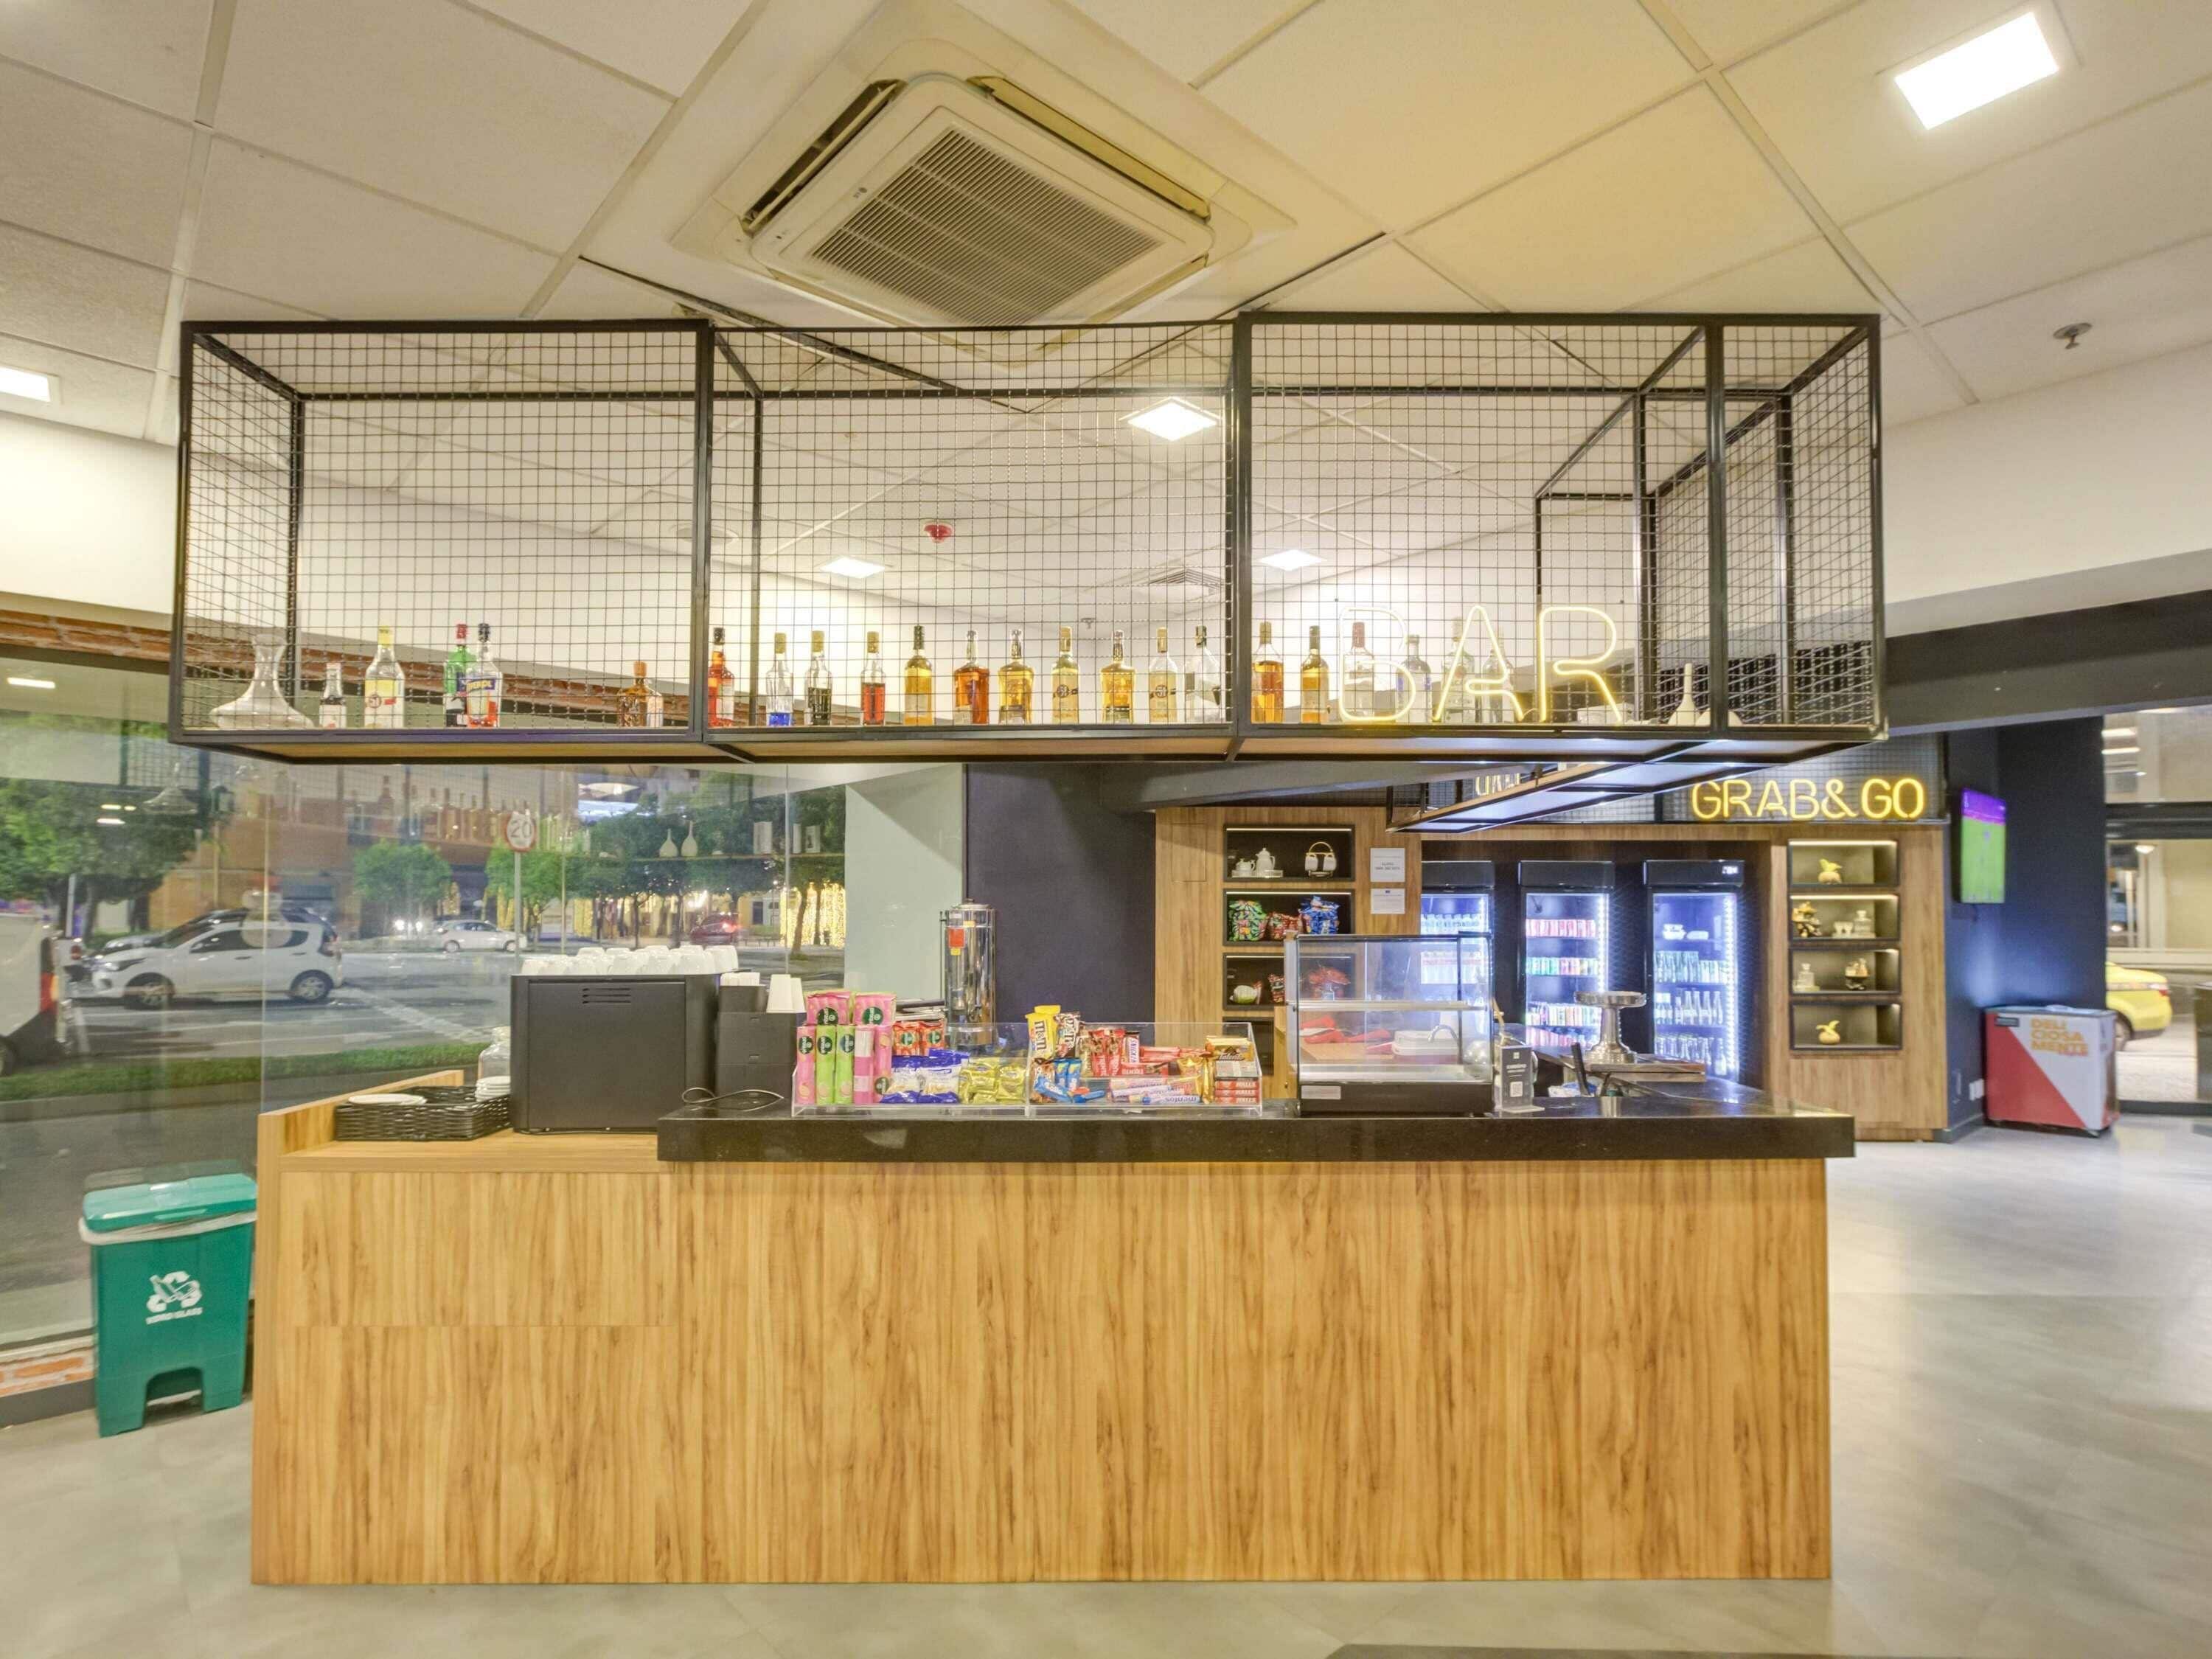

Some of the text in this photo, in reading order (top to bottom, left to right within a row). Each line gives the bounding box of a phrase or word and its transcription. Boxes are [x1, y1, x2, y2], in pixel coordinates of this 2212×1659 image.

[1338, 605, 1624, 723] BAR
[1691, 777, 1926, 820] GRAB& GO
[510, 819, 532, 838] 20
[2030, 1018, 2066, 1029] DELI
[2030, 1040, 2089, 1056] MENTE
